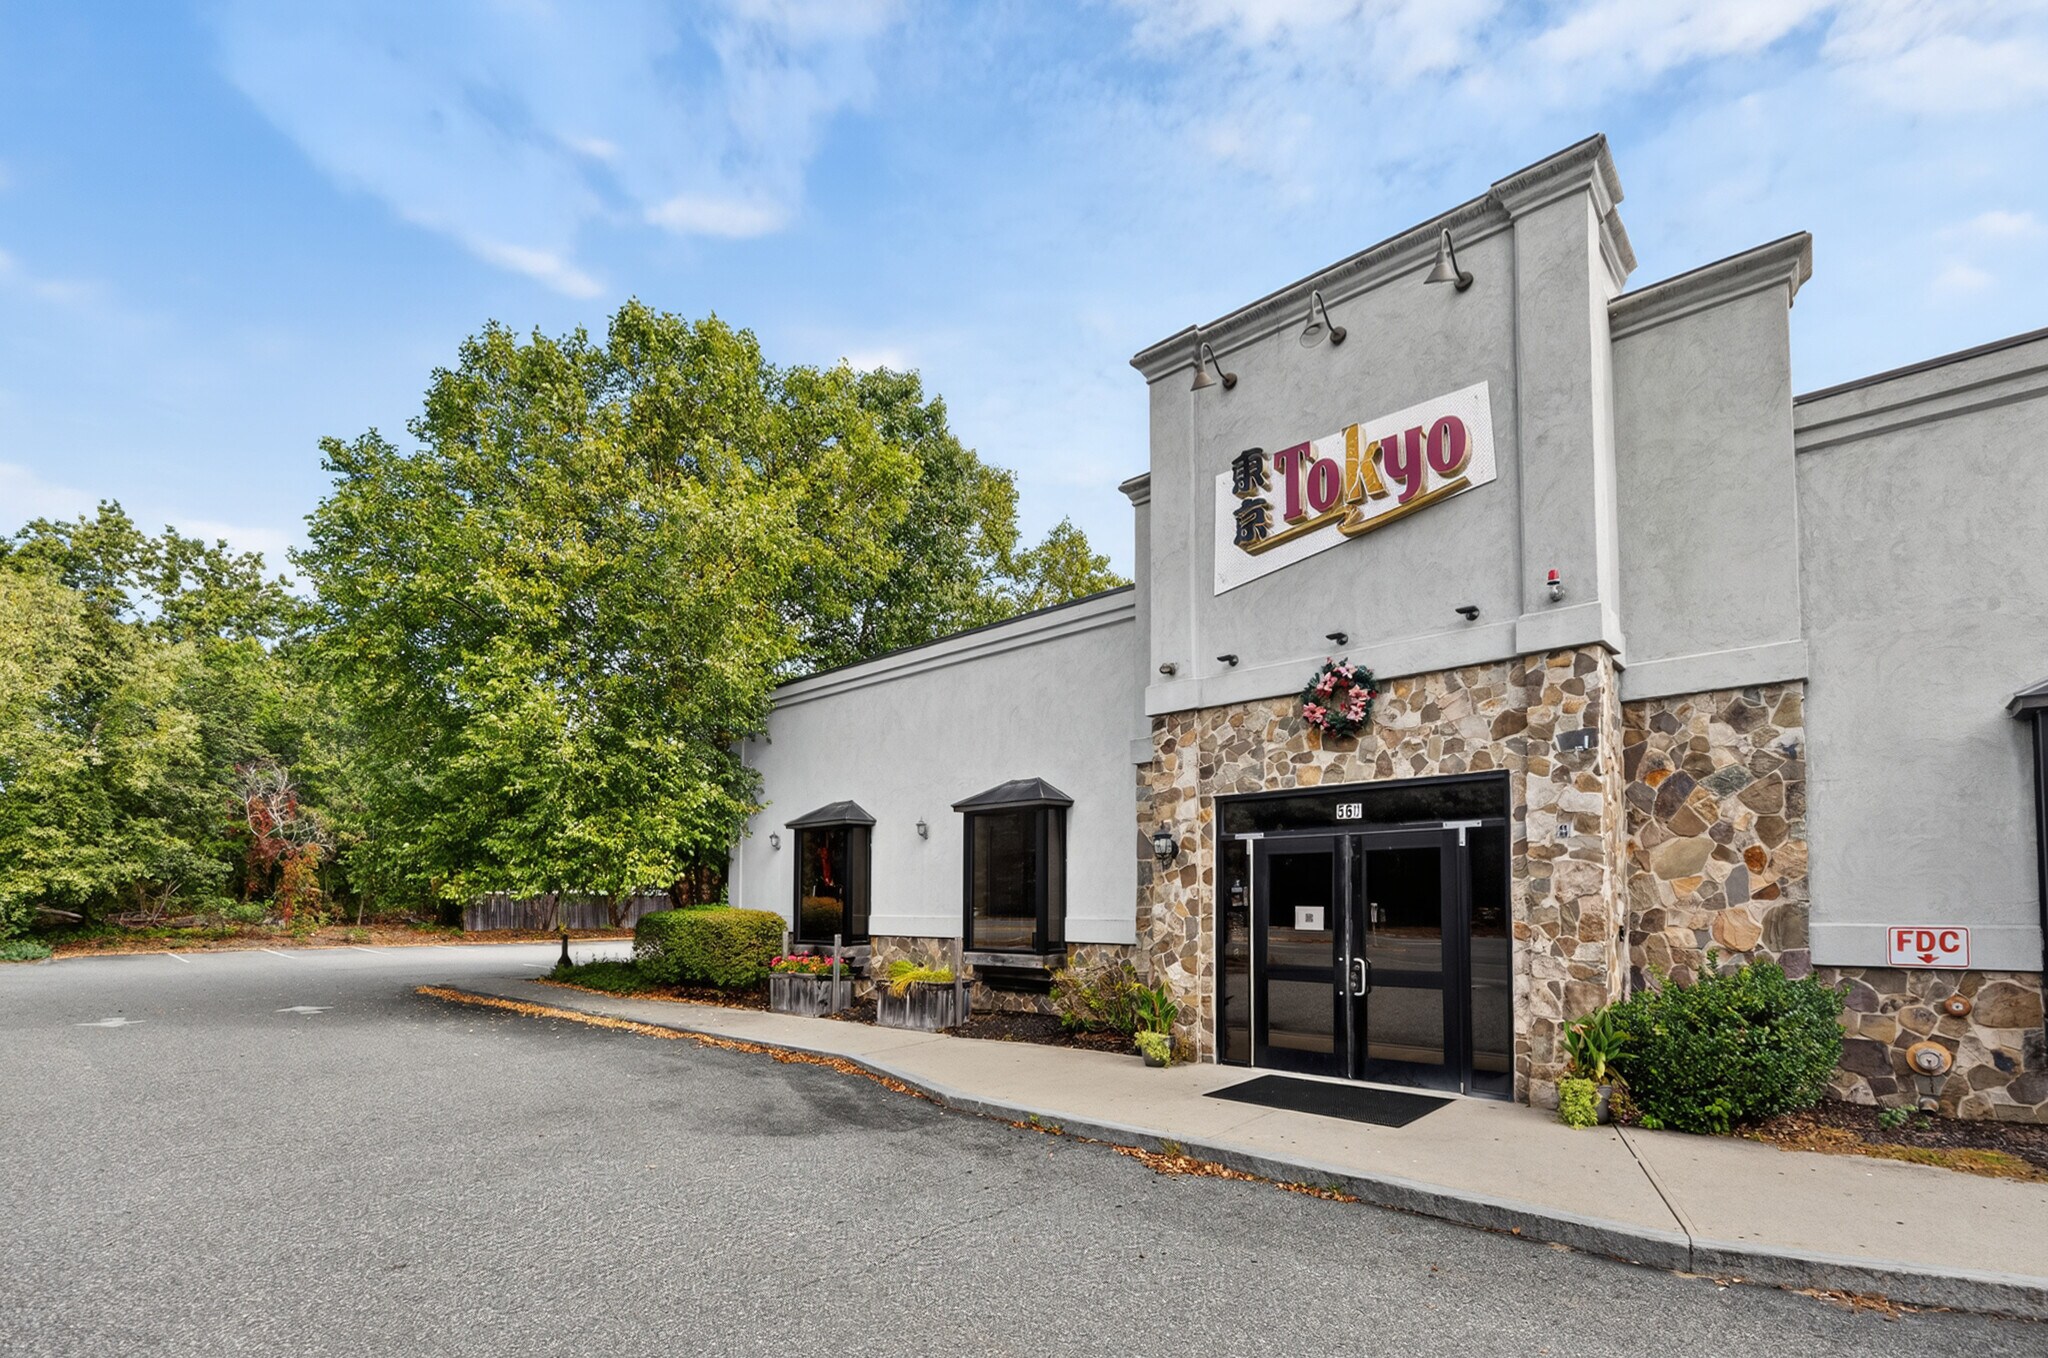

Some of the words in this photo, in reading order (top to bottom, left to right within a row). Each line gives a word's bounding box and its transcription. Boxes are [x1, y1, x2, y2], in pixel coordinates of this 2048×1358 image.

[1232, 447, 1271, 547] 東京
[1273, 415, 1469, 524] Tokyo
[1897, 930, 1960, 953] FDC
